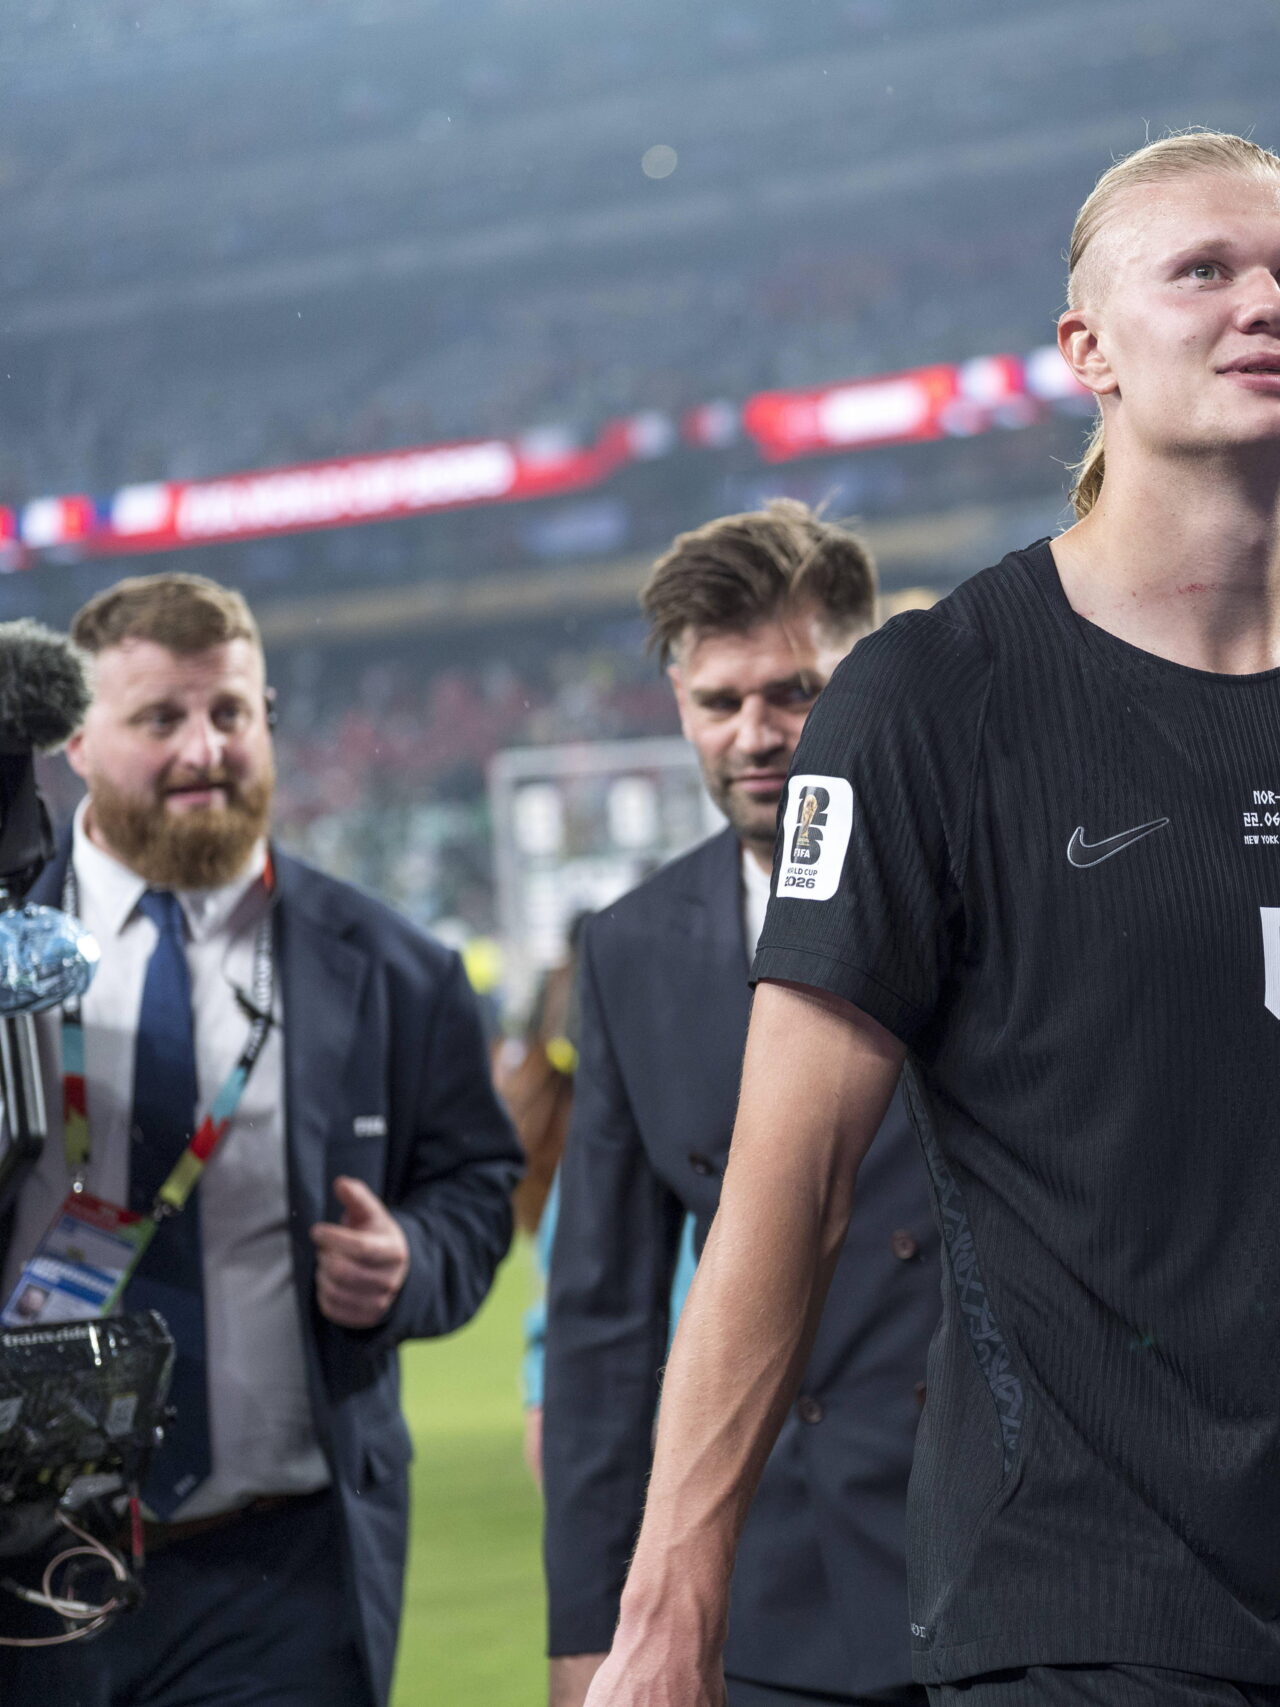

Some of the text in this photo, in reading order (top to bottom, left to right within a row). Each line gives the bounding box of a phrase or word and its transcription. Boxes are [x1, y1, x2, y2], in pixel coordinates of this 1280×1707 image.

[1243, 834, 1260, 845] NEW
[1260, 834, 1280, 845] YORK
[793, 847, 811, 859] FIFA
